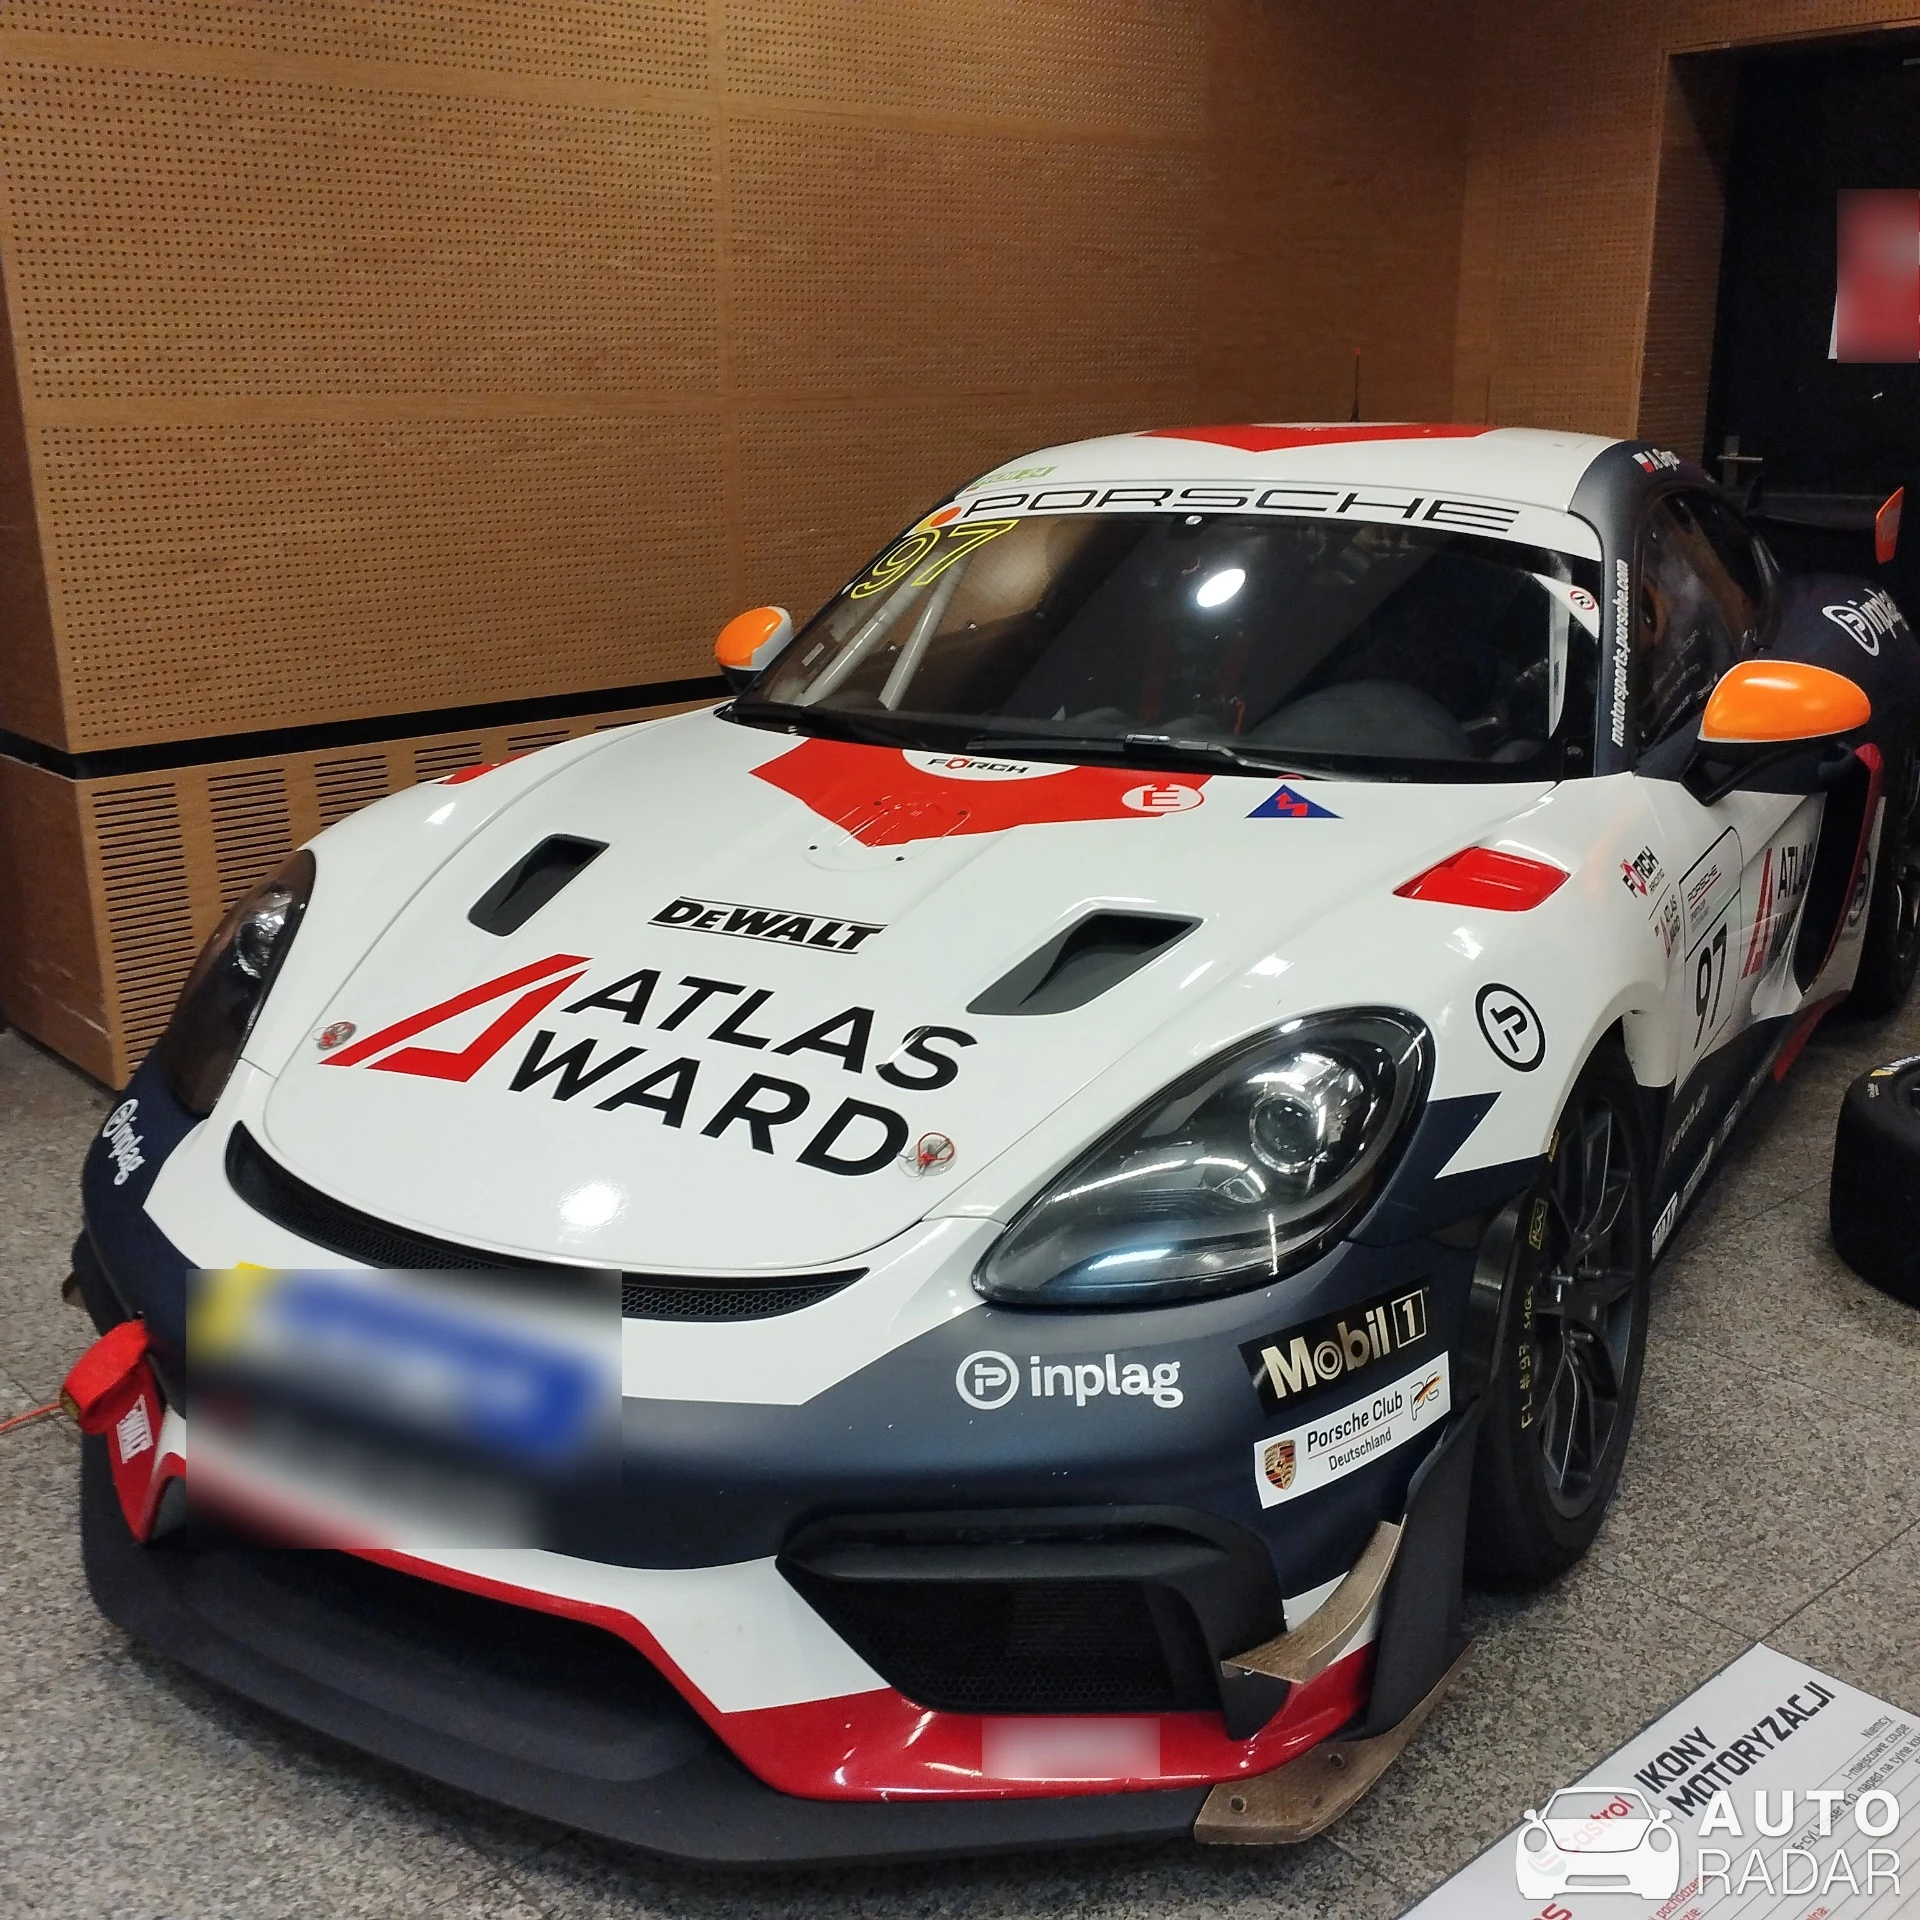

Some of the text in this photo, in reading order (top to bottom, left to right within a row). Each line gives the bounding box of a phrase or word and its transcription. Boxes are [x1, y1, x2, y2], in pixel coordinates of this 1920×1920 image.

[963, 487, 1520, 533] PORSCHE
[850, 518, 1021, 600] 97
[1693, 921, 1728, 1051] 97
[560, 968, 979, 1092] ATLAS
[508, 1029, 910, 1177] WARD
[107, 1115, 146, 1186] inplag
[1030, 1353, 1184, 1410] inplag
[1261, 1299, 1417, 1400] Mobil 1
[1306, 1390, 1404, 1453] Porsche Club
[1328, 1426, 1393, 1471] Deutschland
[1633, 1725, 1717, 1795] IKONY
[1665, 1681, 1836, 1818] MOTORYZACJI
[1860, 1714, 1893, 1739] Niemcy
[1884, 1723, 1910, 1744] coupe
[1880, 1763, 1894, 1774] na
